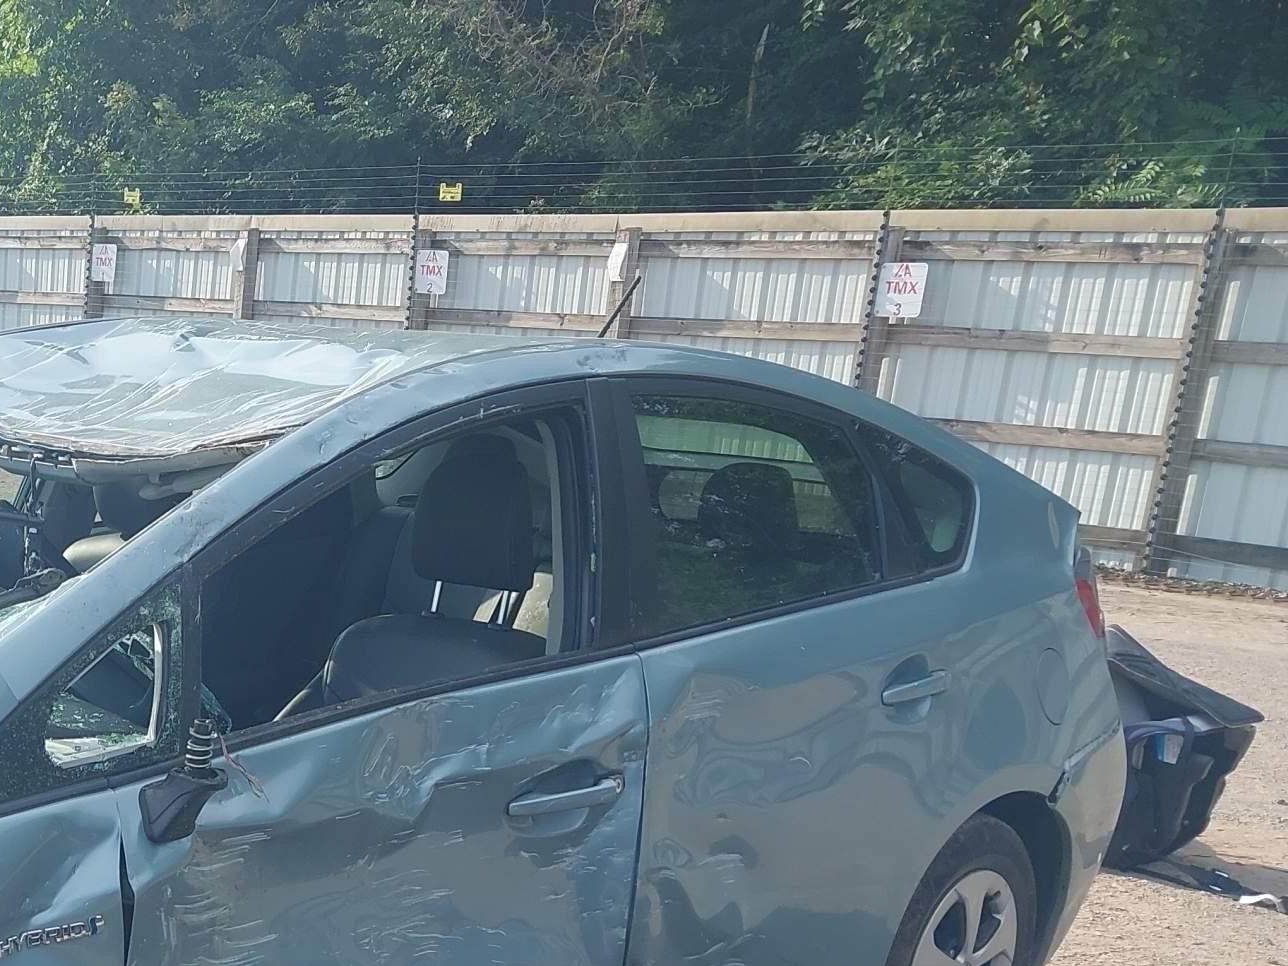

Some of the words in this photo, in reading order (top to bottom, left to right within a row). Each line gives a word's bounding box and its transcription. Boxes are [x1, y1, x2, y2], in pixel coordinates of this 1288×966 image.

[95, 257, 113, 267] TMX
[420, 264, 443, 276] TMX
[426, 283, 433, 293] 2
[885, 281, 919, 295] TMX
[893, 303, 902, 316] 3
